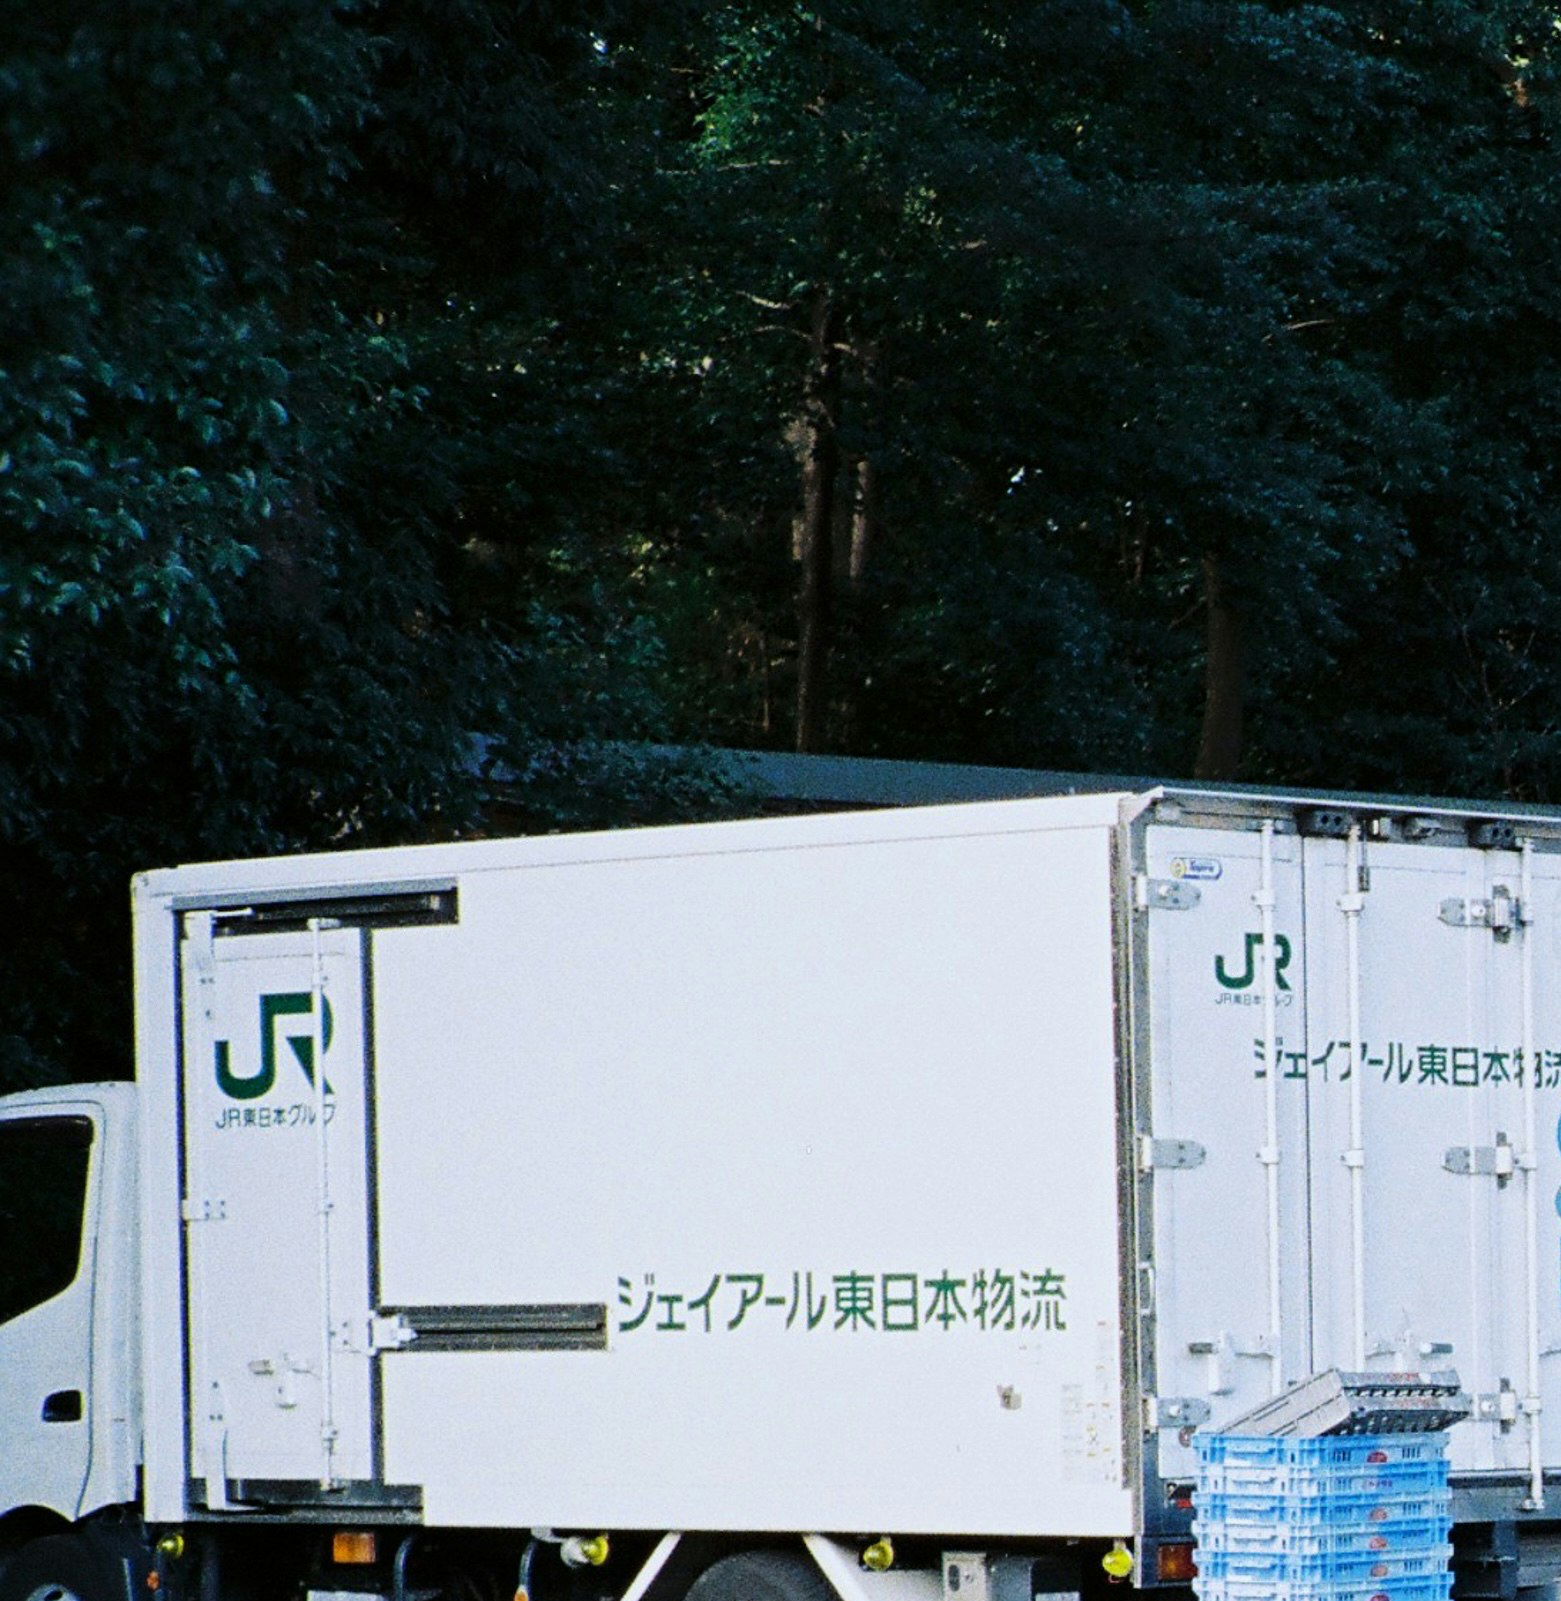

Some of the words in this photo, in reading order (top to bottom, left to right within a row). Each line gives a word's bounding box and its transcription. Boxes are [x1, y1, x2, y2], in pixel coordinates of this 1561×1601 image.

[1214, 932, 1292, 991] JR
[214, 991, 335, 1101] JR
[215, 1103, 336, 1130] JR東日本グルプ
[618, 1268, 1067, 1332] ジェイアール東日本物流
